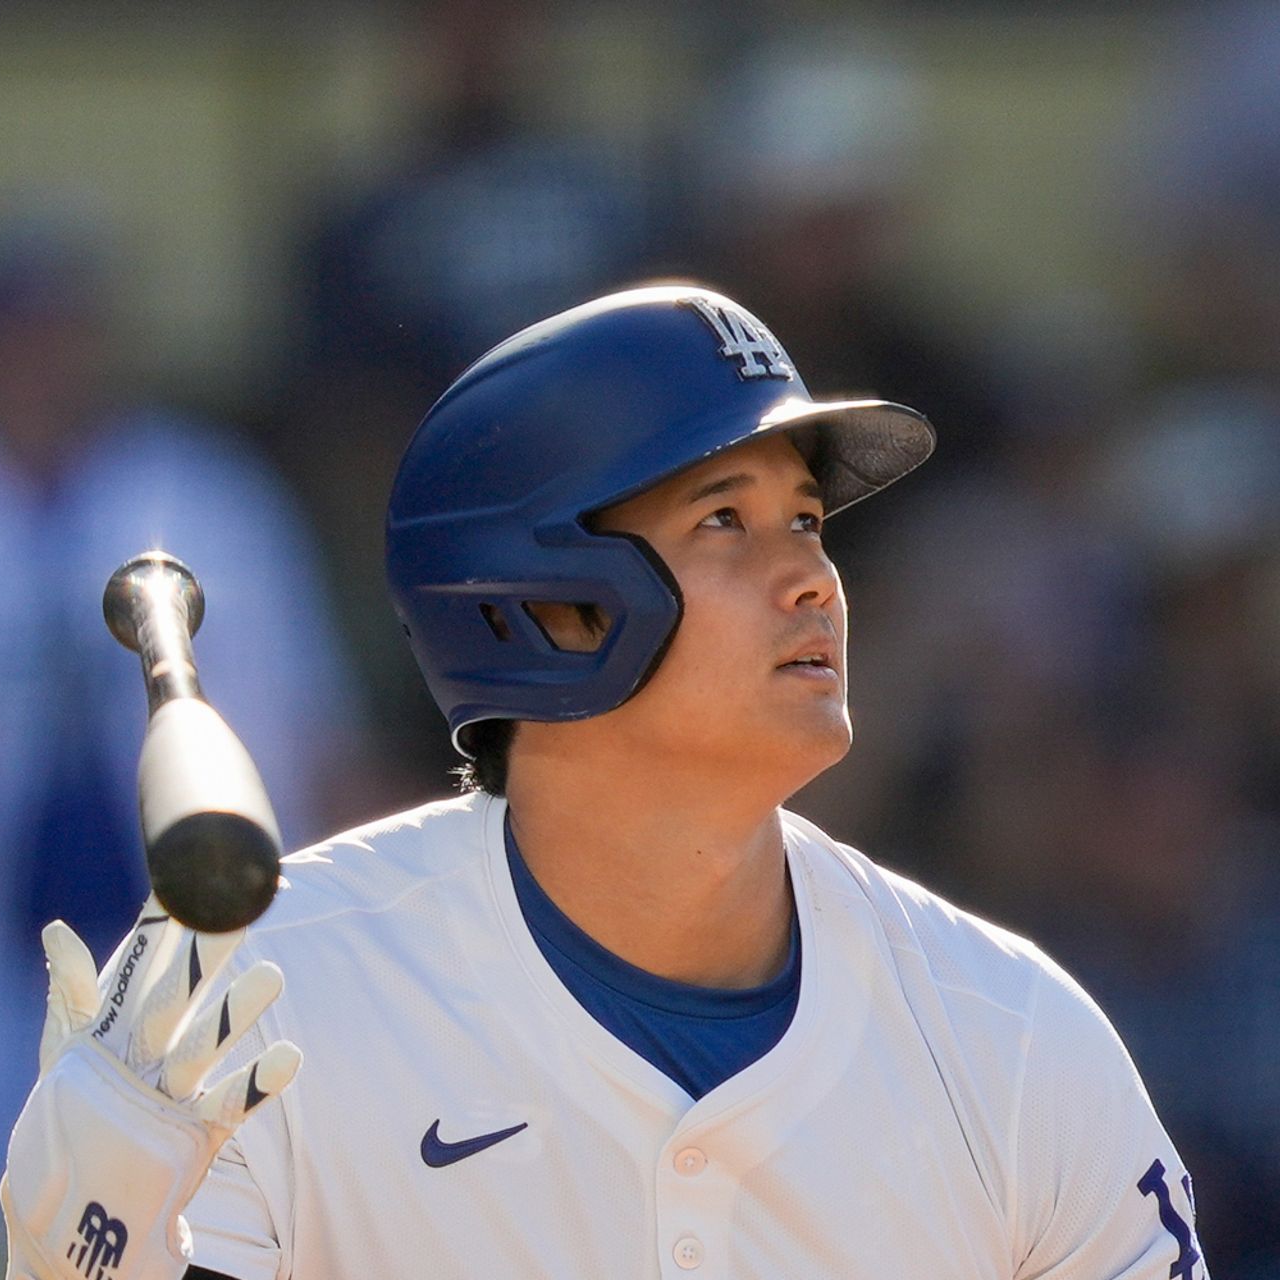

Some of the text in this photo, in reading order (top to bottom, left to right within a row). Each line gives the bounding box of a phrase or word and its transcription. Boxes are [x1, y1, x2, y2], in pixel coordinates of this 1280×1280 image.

[675, 297, 794, 382] LA
[91, 933, 148, 1039] new balance
